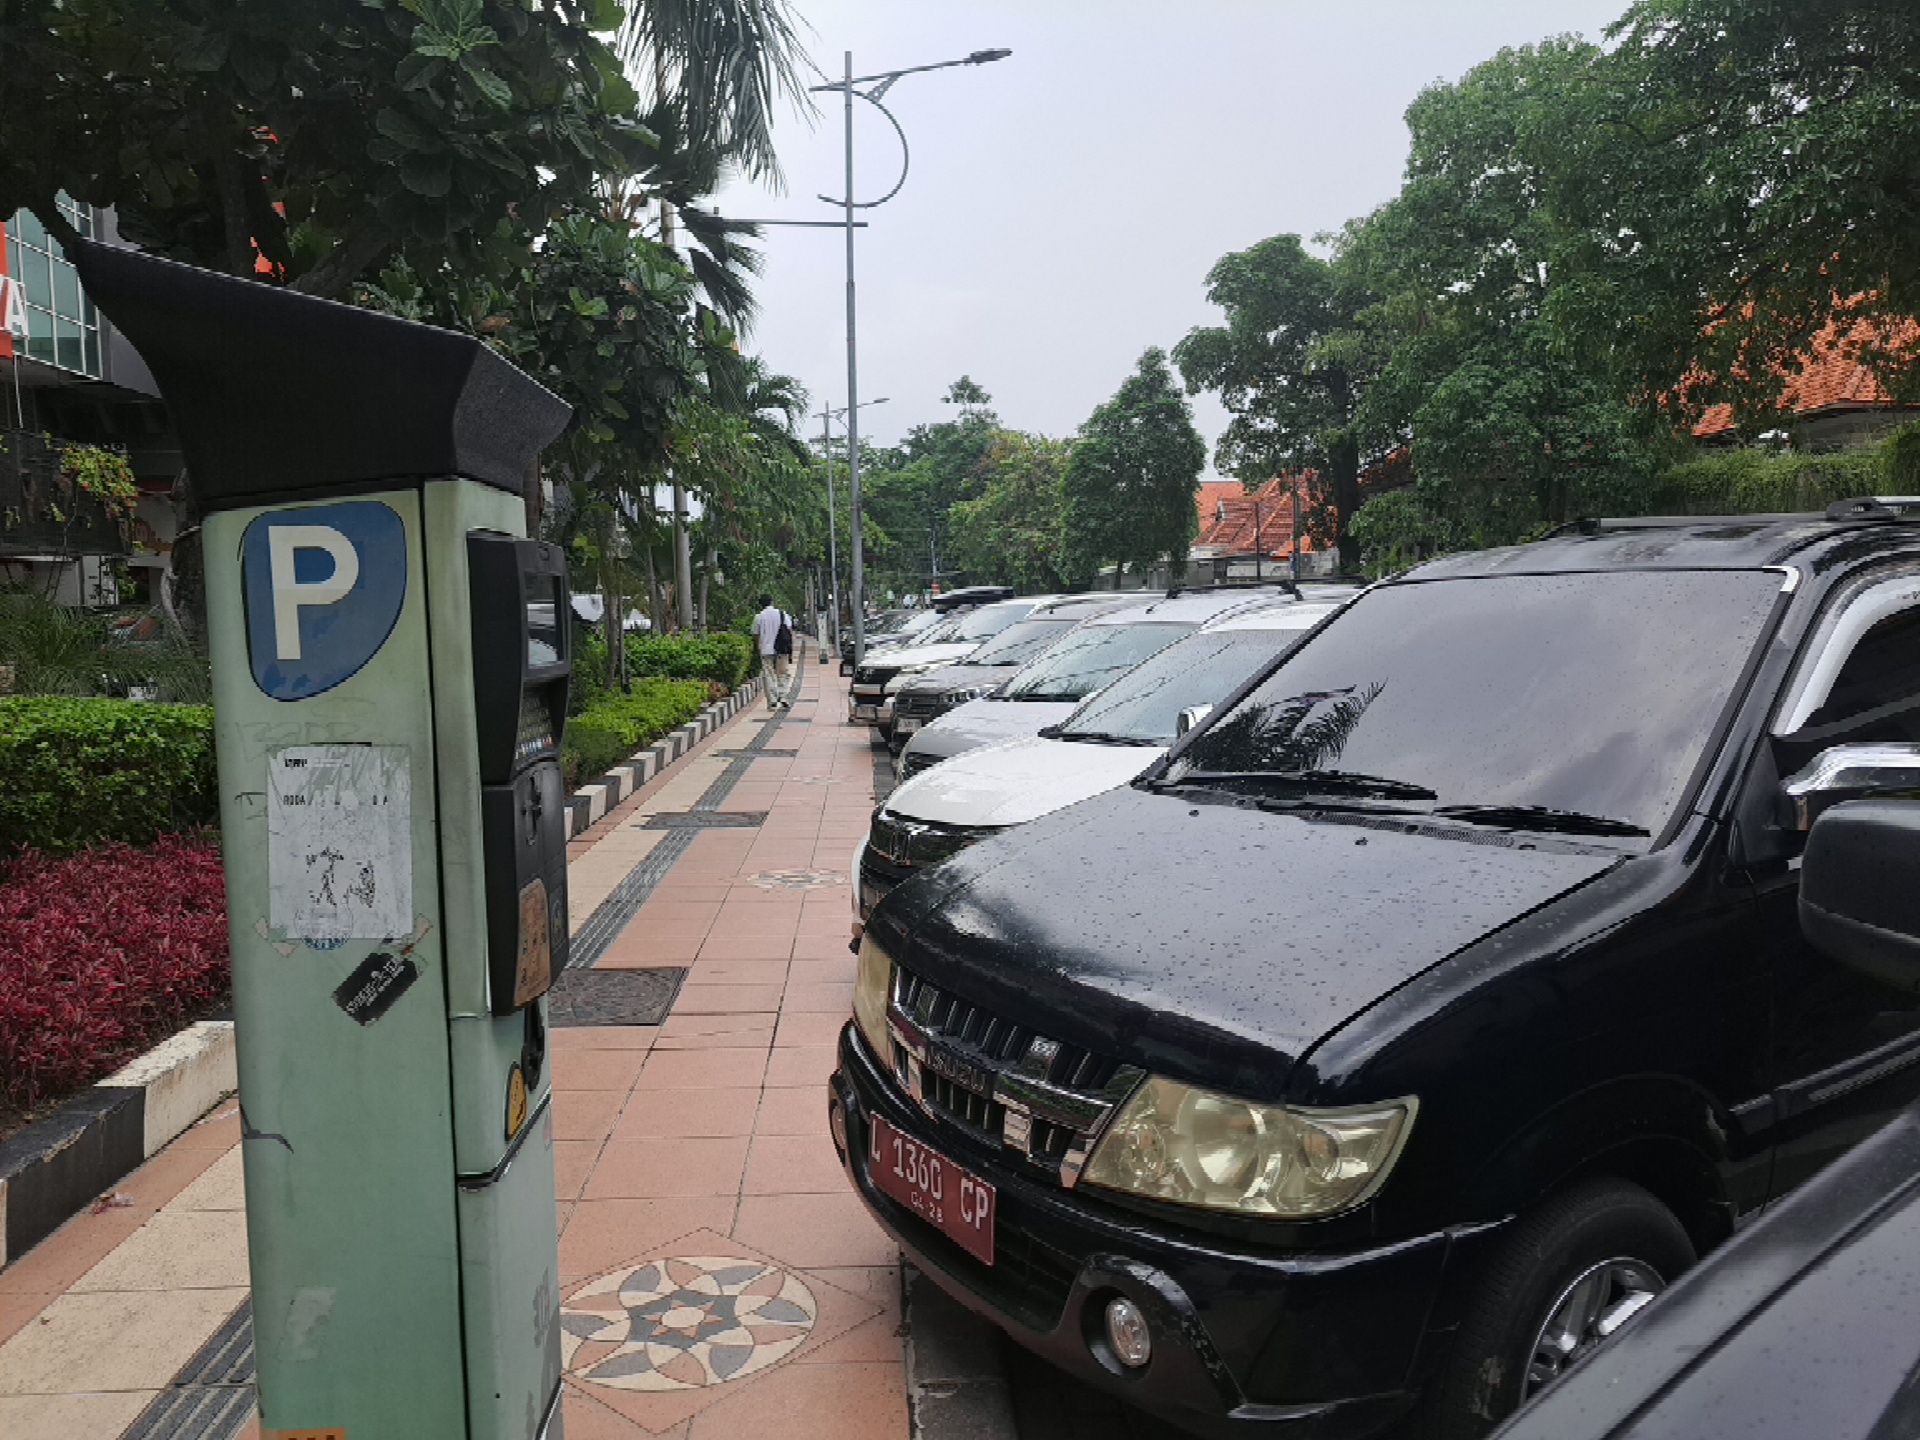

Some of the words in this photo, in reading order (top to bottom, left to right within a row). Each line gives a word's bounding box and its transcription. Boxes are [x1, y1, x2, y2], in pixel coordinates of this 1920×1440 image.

[268, 526, 359, 660] P
[871, 1119, 881, 1163] L
[893, 1138, 942, 1200] 1360
[961, 1177, 989, 1230] CP
